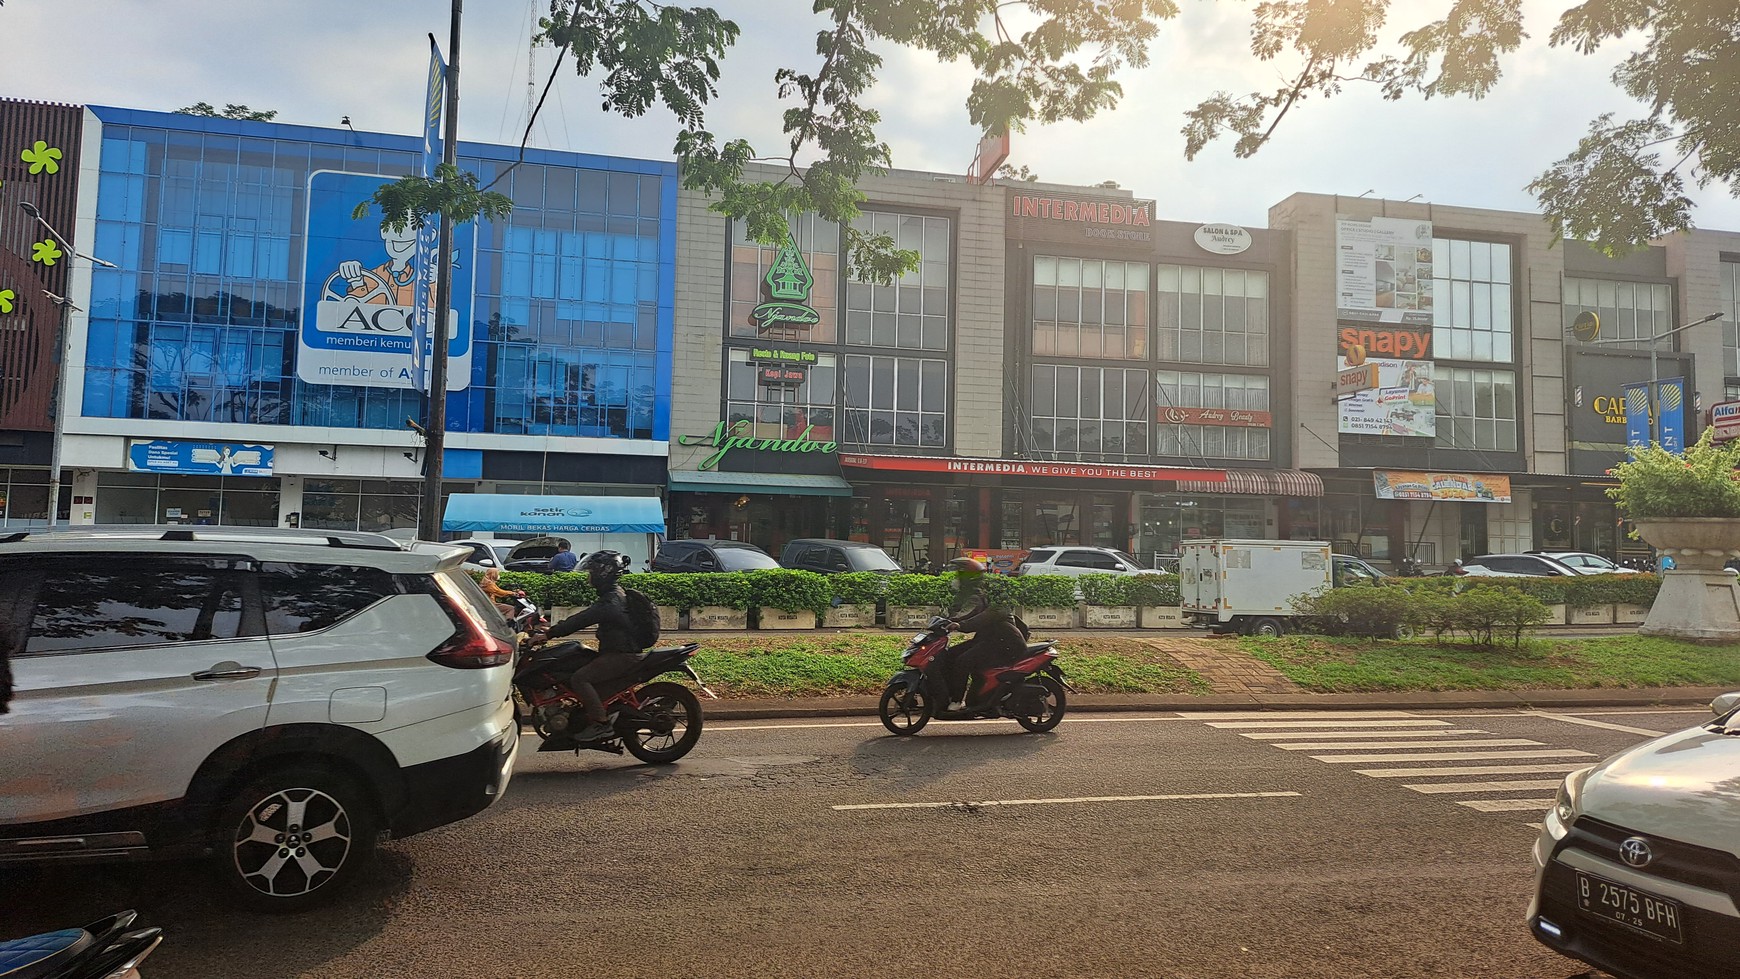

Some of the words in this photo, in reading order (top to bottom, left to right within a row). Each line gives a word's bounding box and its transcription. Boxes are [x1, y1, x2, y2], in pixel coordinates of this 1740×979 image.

[1013, 195, 1150, 226] INTERMEDIA
[1085, 227, 1116, 239] BOOK
[1203, 227, 1224, 235] SALON
[326, 335, 378, 347] memberi
[1341, 327, 1431, 359] snapy
[319, 365, 373, 377] member
[379, 366, 394, 378] of
[1340, 370, 1368, 386] snapy
[1714, 406, 1740, 418] Alfa
[678, 419, 837, 471] Njandoe
[1031, 466, 1048, 474] WE
[1052, 467, 1076, 475] GIVE
[1080, 468, 1102, 476] YOU
[1106, 469, 1126, 477] THE
[1130, 470, 1157, 478] BEST
[1432, 480, 1474, 492] CALENDAR
[1581, 877, 1589, 898] B
[1600, 883, 1640, 914] 2575
[1645, 899, 1677, 929] BFH
